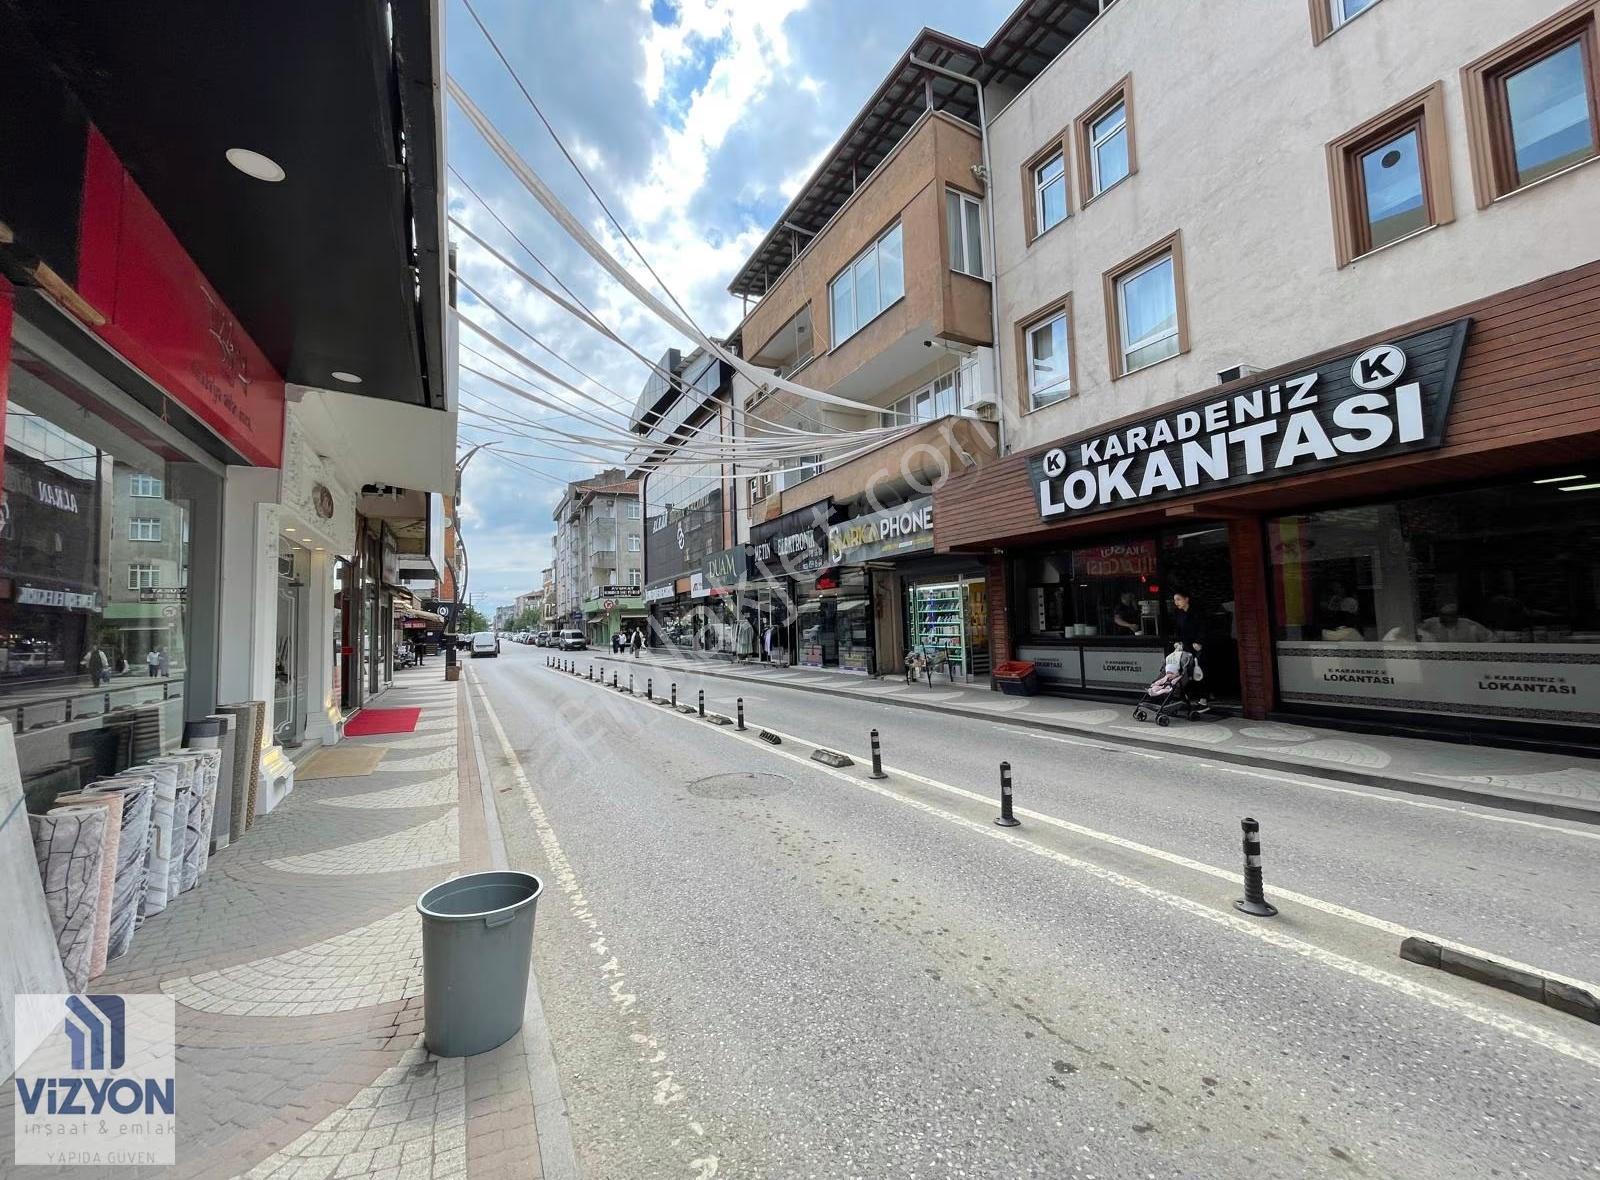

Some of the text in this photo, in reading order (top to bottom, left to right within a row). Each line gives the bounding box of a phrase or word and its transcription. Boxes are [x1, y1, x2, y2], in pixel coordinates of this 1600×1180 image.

[1040, 382, 1425, 517] LOKANTASI
[880, 505, 933, 540] PHONE
[1324, 674, 1395, 685] LOKANTASI
[1478, 681, 1577, 695] LOKANTASI
